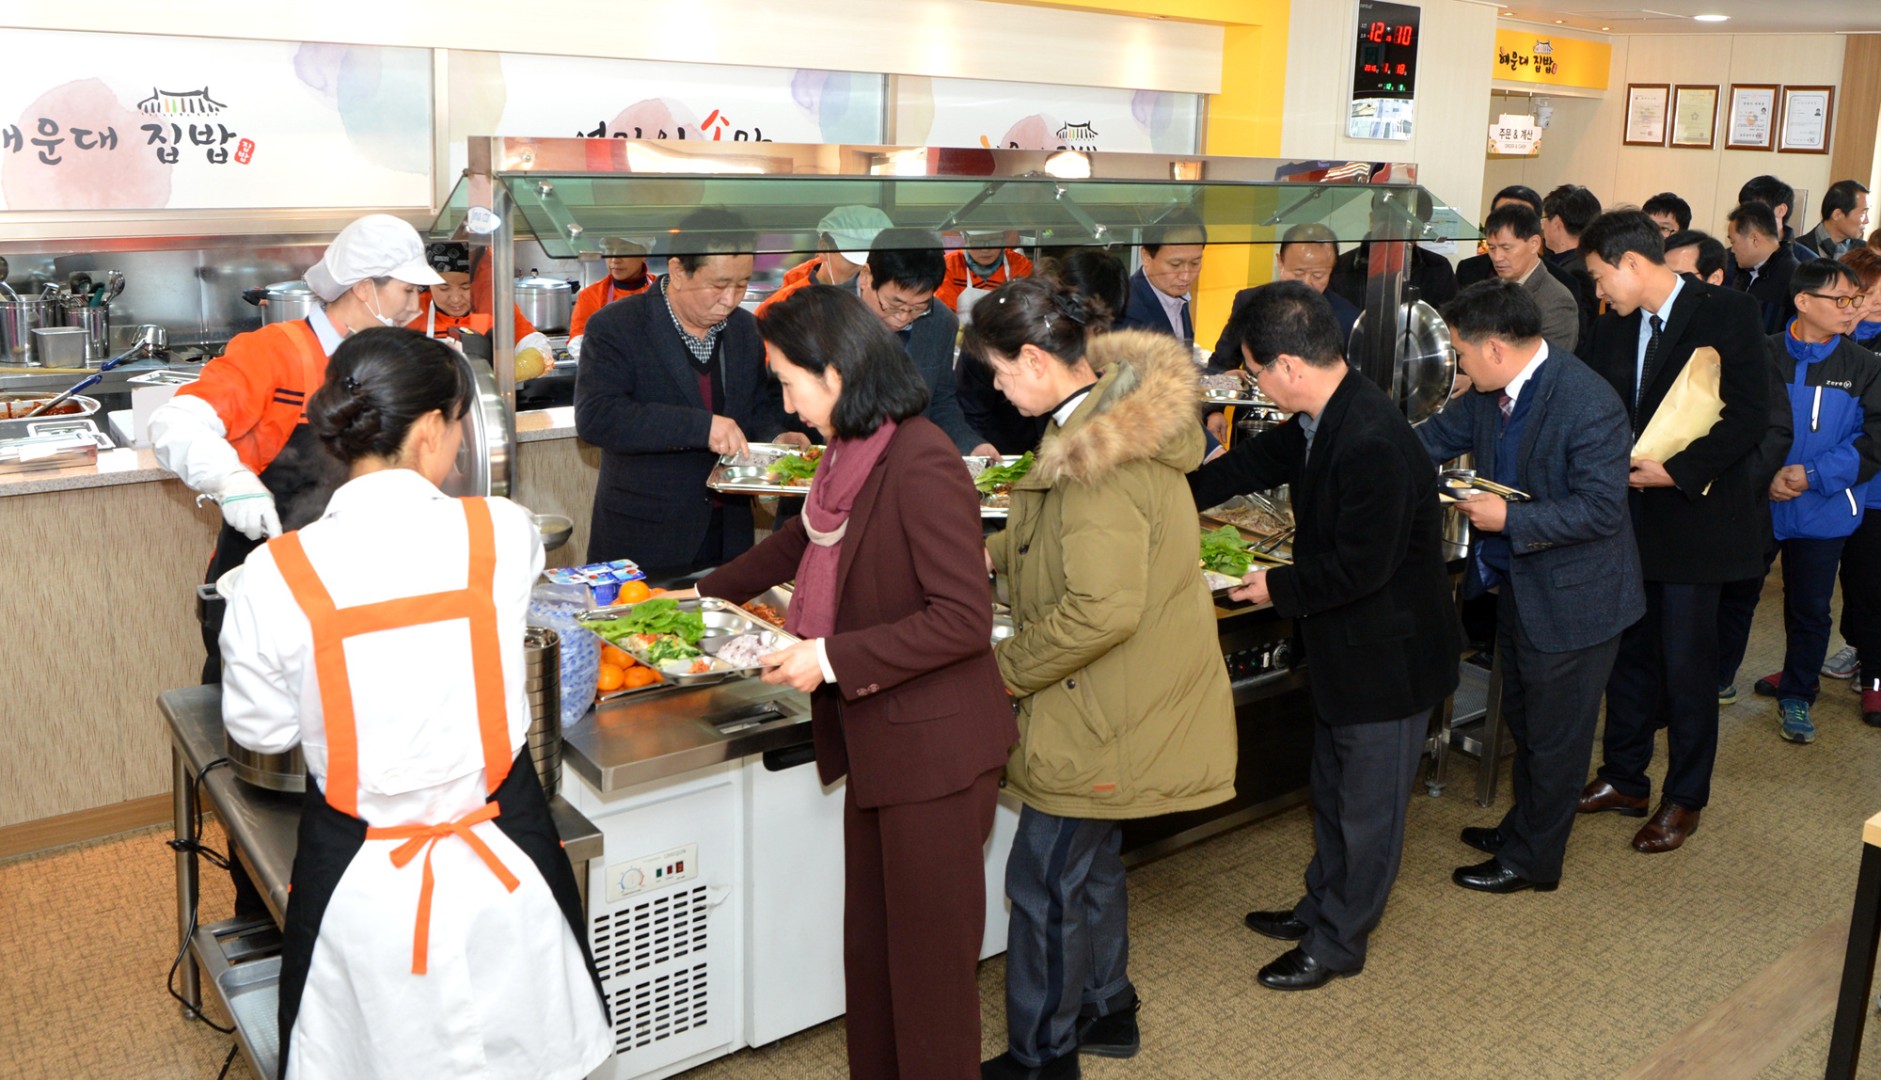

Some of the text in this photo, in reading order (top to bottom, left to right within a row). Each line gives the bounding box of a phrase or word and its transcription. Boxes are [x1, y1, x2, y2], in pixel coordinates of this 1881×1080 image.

[1498, 47, 1554, 74] 해운대 집밥
[141, 123, 237, 165] 집밥
[1499, 128, 1511, 140] 주문
[1521, 129, 1533, 141] 계산
